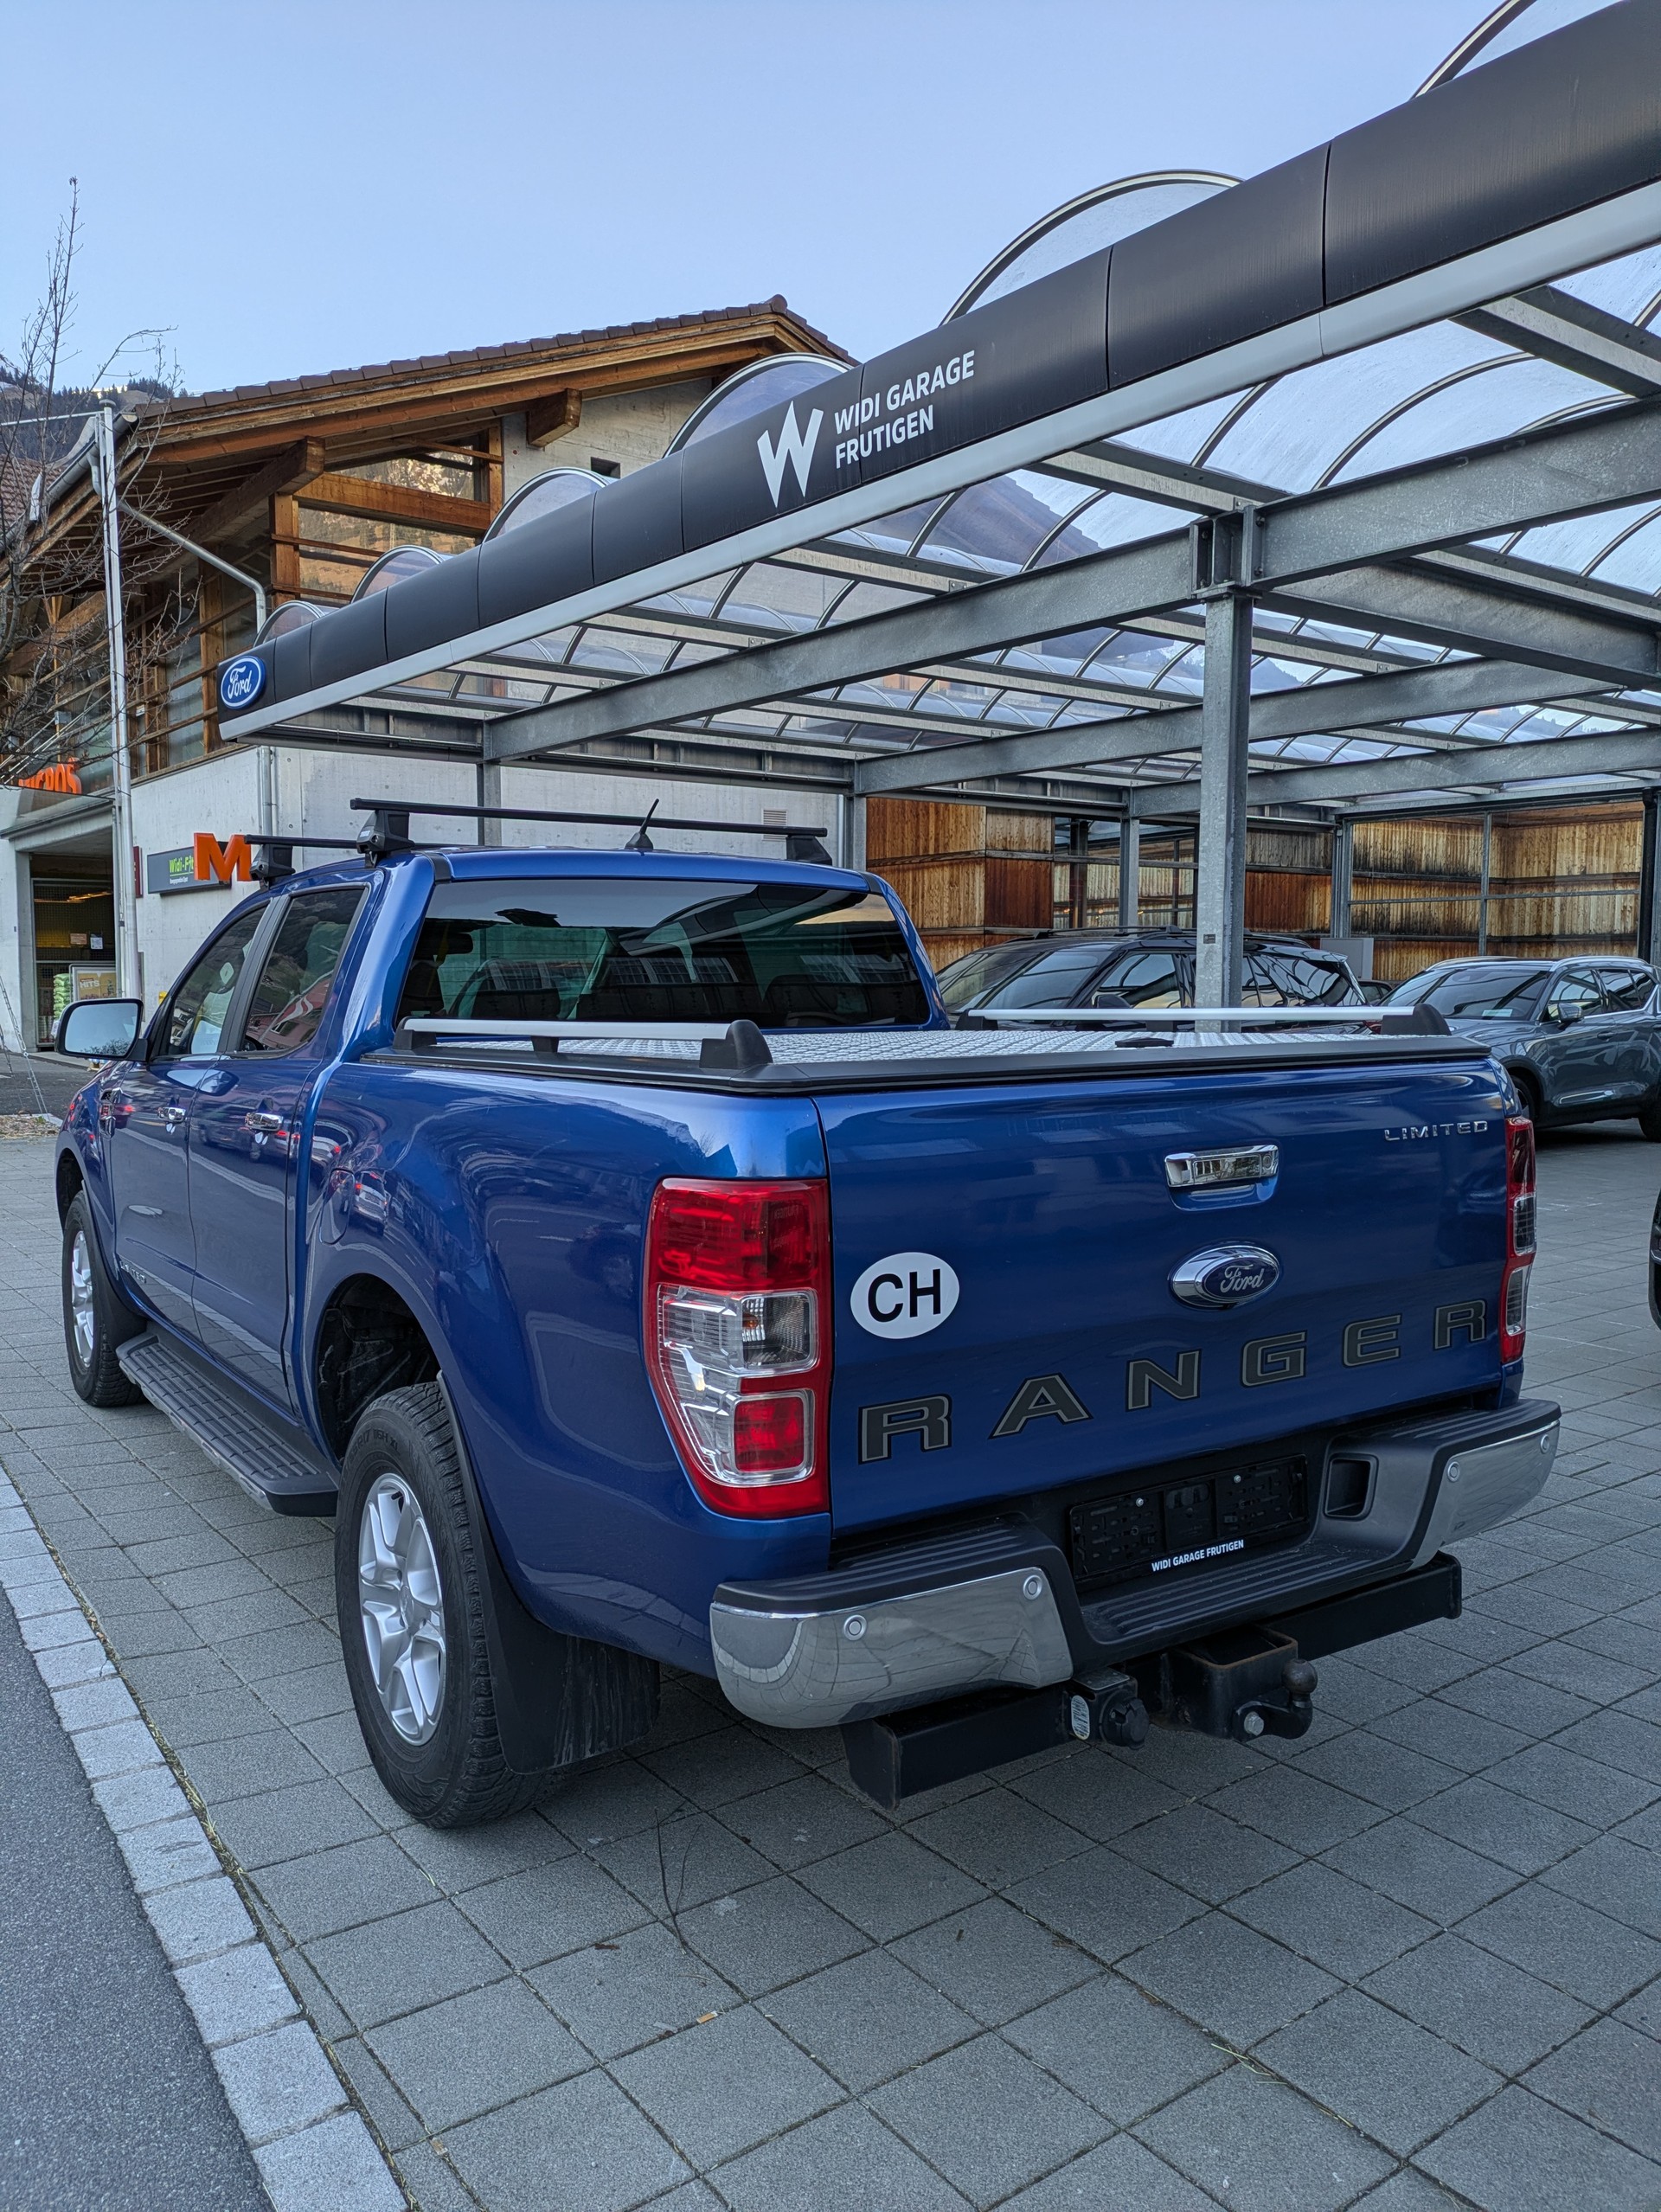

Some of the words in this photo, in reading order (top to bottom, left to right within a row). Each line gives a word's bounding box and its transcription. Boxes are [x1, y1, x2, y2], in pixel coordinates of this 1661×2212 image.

[834, 393, 880, 435] WIDI
[886, 349, 975, 411] GARAGE
[836, 405, 933, 470] FRUTIGEN
[227, 665, 253, 700] Ford
[1384, 1120, 1488, 1141] LIMITED
[867, 1268, 941, 1323] CH
[1219, 1264, 1265, 1293] Ford
[858, 1298, 1488, 1465] RANGER
[1151, 1560, 1171, 1572] WIDI
[1172, 1549, 1205, 1566] GARAGE
[1206, 1539, 1244, 1557] FRUTIGEN
